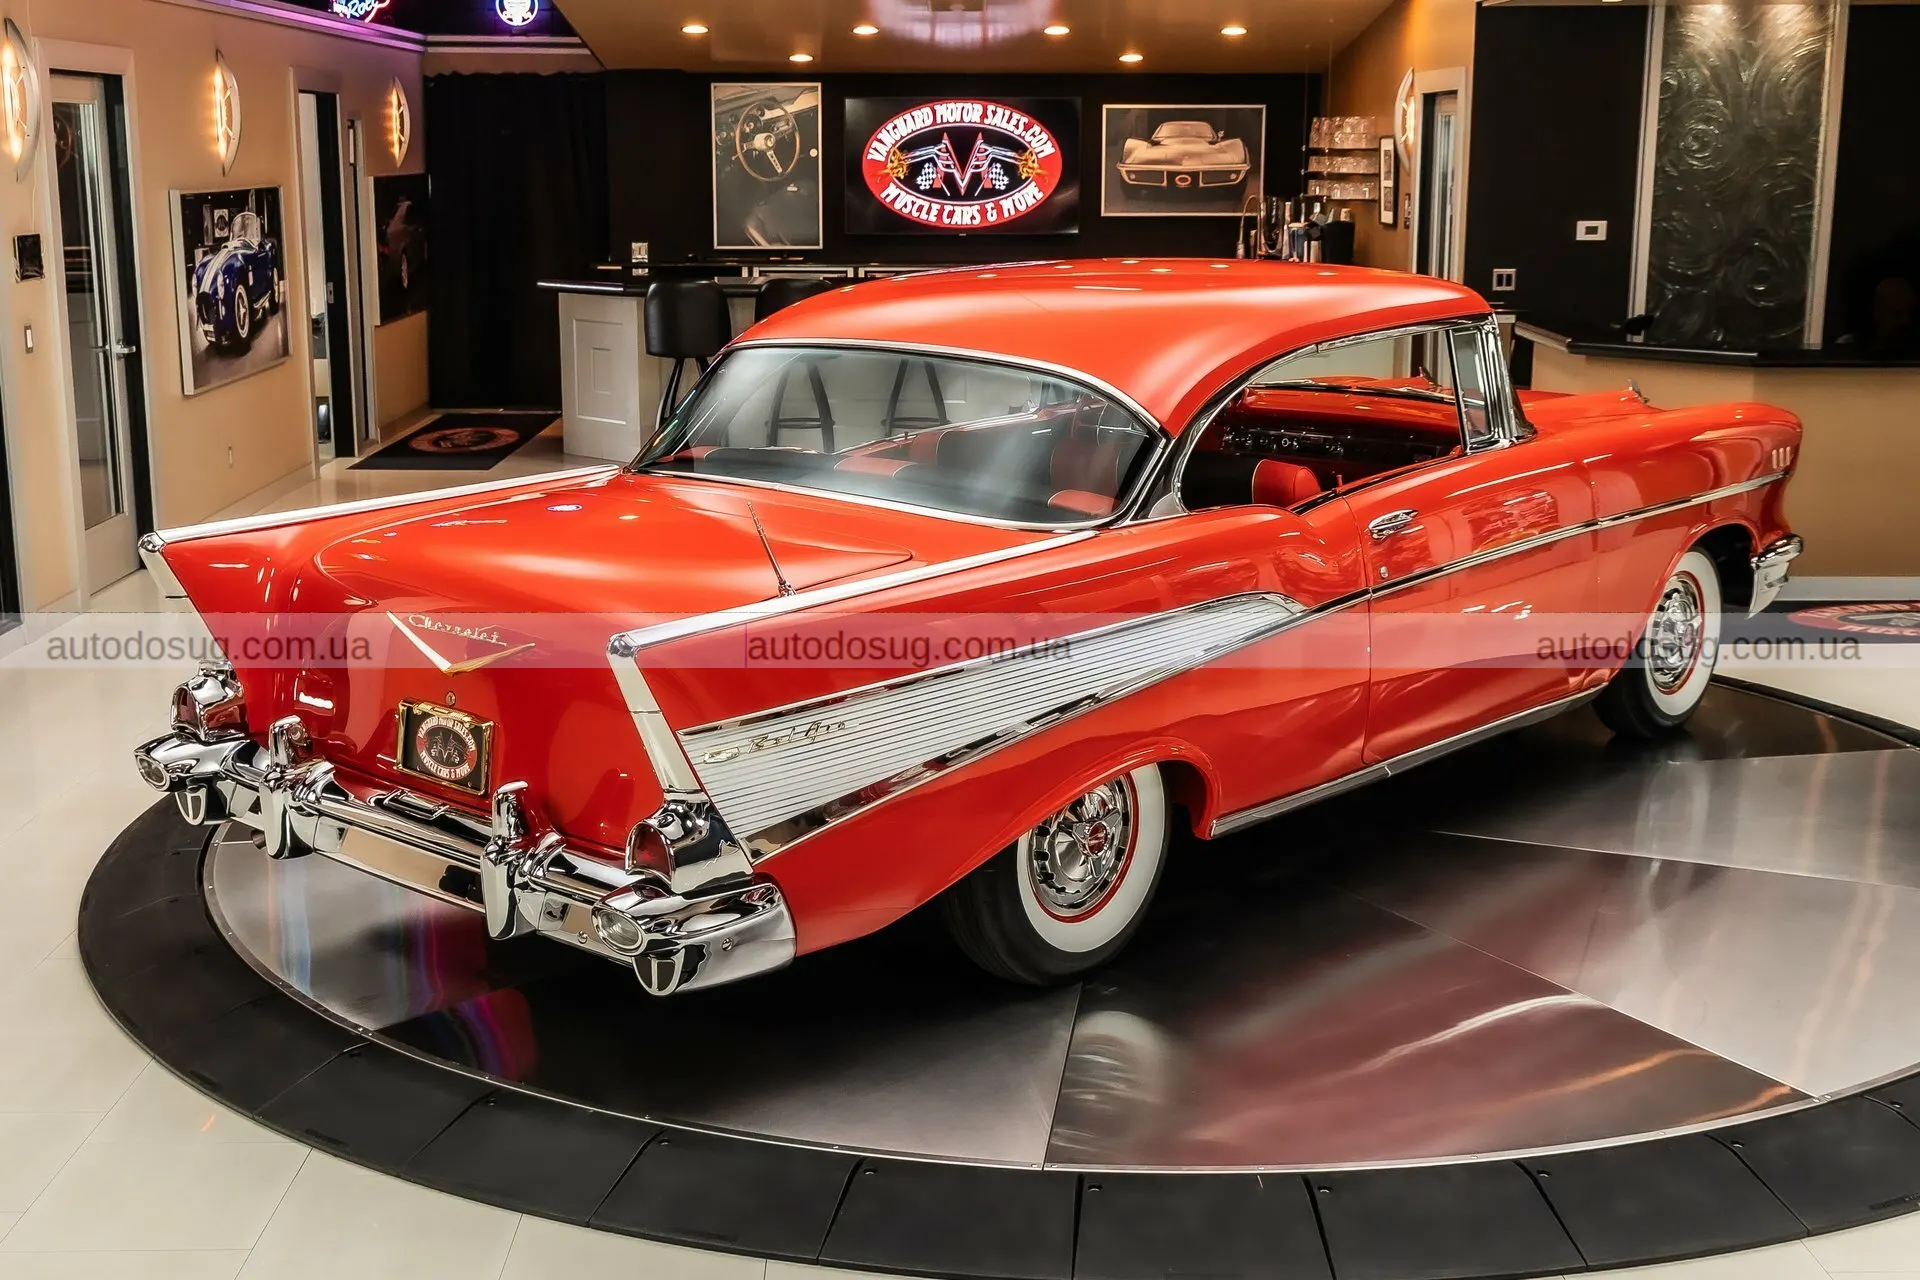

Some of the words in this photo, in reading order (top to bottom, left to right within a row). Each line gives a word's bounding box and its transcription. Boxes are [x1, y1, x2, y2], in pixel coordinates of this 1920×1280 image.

[866, 106, 933, 163] VANGUARD
[934, 102, 983, 124] MOTOR
[984, 104, 1056, 159] SALES.COM
[879, 183, 942, 223] MUSCLE
[942, 205, 981, 225] CARS
[986, 202, 998, 222] &
[999, 181, 1044, 218] MORE
[408, 614, 508, 647] Chevrolet
